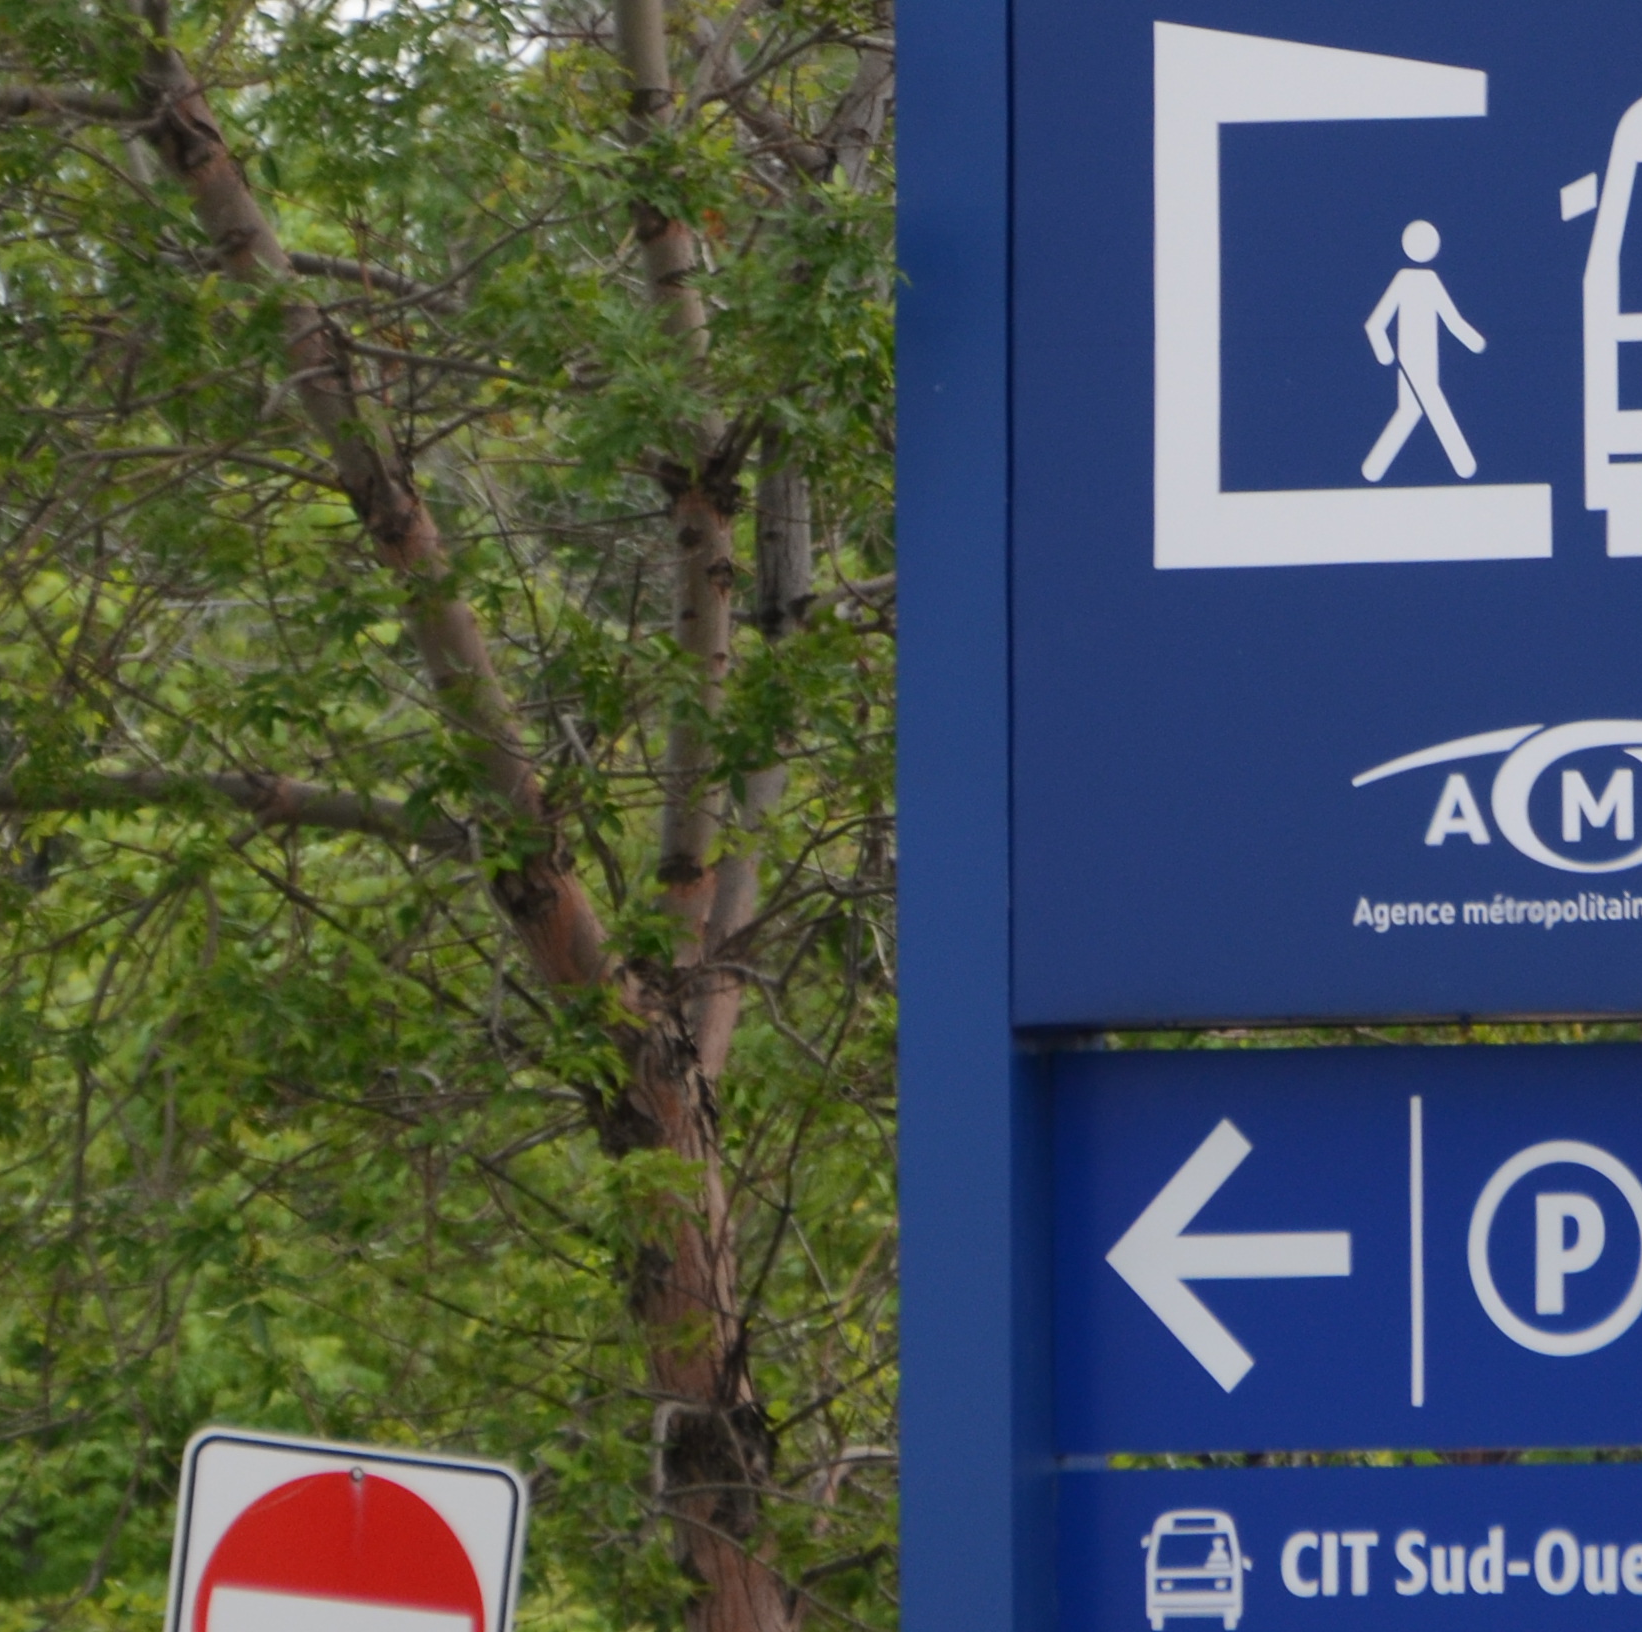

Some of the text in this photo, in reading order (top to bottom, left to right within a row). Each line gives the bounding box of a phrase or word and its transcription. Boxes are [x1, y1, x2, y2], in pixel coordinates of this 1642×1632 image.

[1353, 896, 1456, 933] Agence
[1535, 1191, 1606, 1316] P
[1280, 1530, 1379, 1597] CIT
